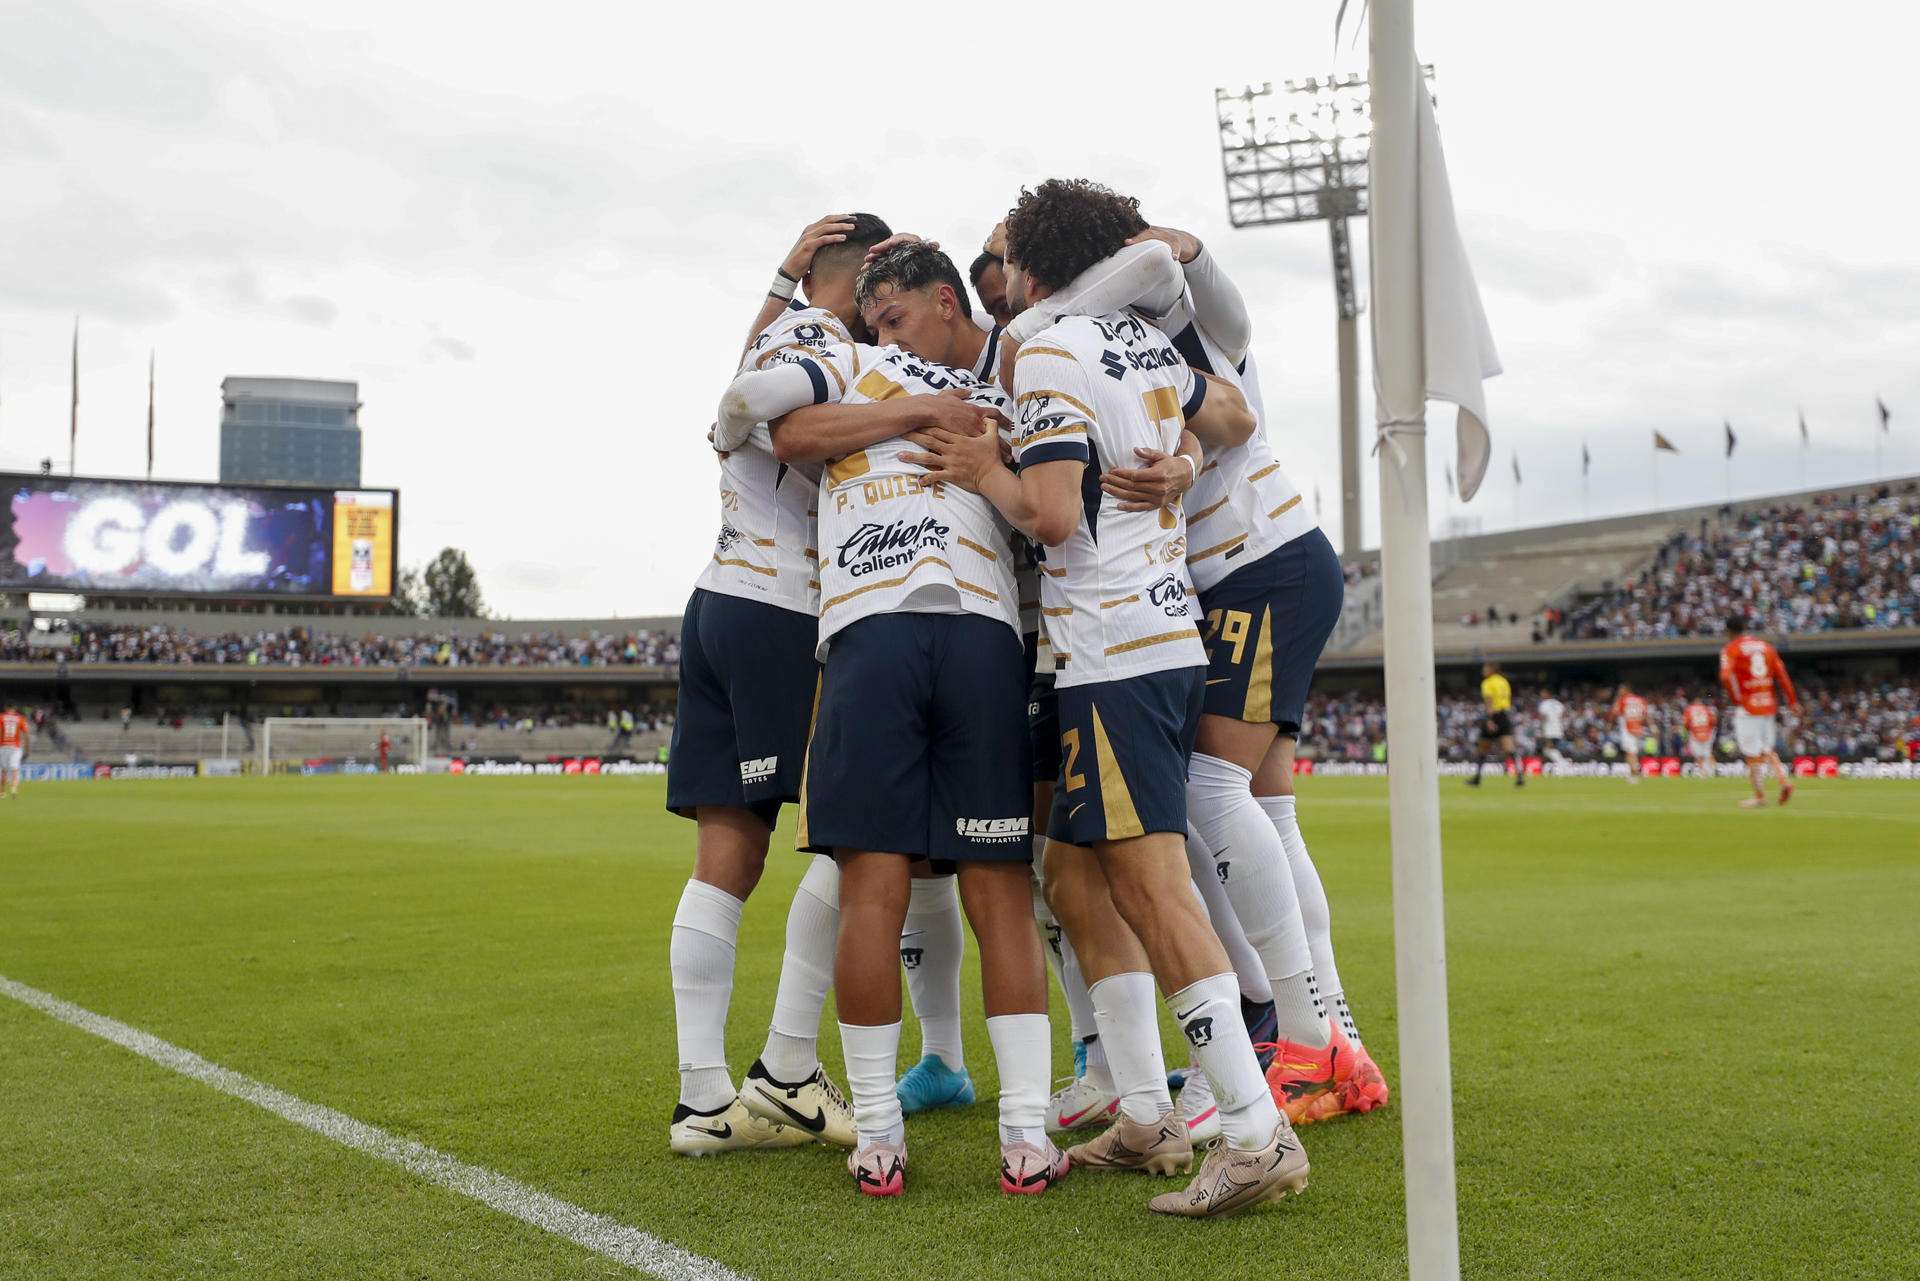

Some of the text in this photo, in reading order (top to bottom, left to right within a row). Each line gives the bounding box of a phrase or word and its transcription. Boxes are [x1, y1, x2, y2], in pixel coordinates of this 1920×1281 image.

[798, 339, 826, 349] Berel
[864, 474, 946, 505] QUISE
[64, 497, 271, 577] GOL
[740, 756, 778, 775] EM
[1061, 727, 1086, 793] 2
[966, 818, 1029, 833] KEM
